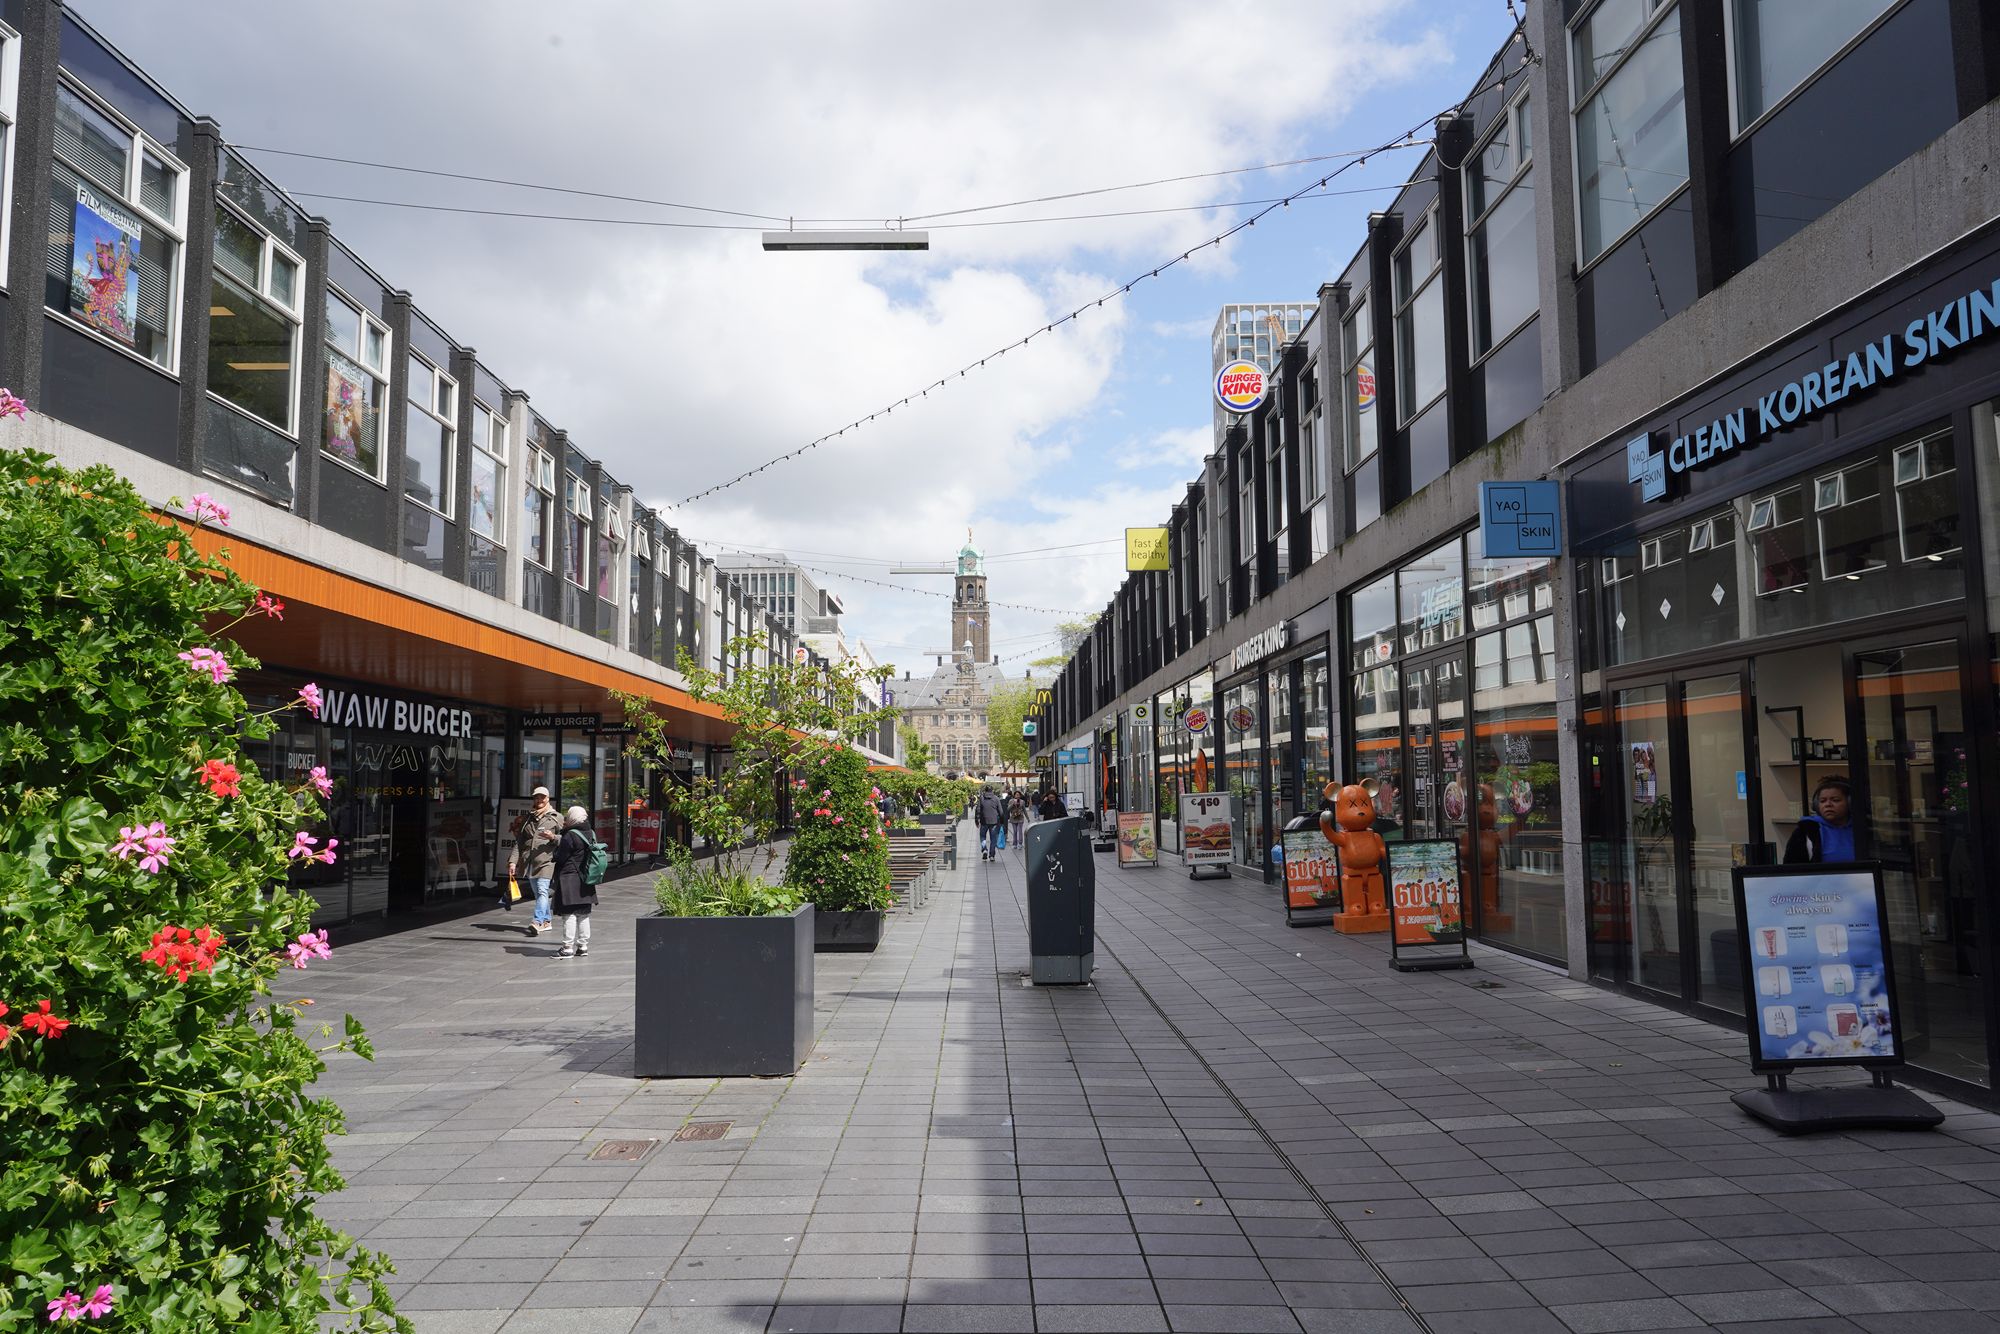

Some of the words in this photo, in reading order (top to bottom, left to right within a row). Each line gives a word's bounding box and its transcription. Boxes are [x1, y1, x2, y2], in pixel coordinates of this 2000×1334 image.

[80, 189, 101, 213] FILM
[1222, 373, 1262, 385] BURGER
[1669, 407, 1746, 473] CLEAN
[1758, 334, 1894, 435] KOREAN
[1904, 278, 2000, 367] SKIN
[1222, 382, 1262, 396] KING
[1631, 450, 1646, 465] YAO
[1644, 467, 1662, 485] SKIN
[1495, 501, 1521, 511] YAO
[1521, 527, 1551, 537] SKIN
[1134, 539, 1151, 548] fast
[1155, 539, 1162, 548] &
[1131, 551, 1166, 560] healthy
[1236, 633, 1264, 670] BURGER
[1264, 620, 1286, 656] KING
[318, 688, 389, 729] WAW
[394, 700, 472, 739] BURGER
[1187, 711, 1205, 722] BURGER
[523, 717, 552, 727] WAW
[555, 717, 595, 726] BURGER
[1188, 718, 1207, 727] KING
[287, 752, 316, 770] BUCKET
[508, 809, 519, 817] THE
[631, 816, 660, 828] sale
[1771, 894, 1808, 906] glowing
[1811, 893, 1830, 901] skin
[1833, 892, 1841, 901] is
[1786, 905, 1820, 916] always
[1820, 906, 1831, 914] in
